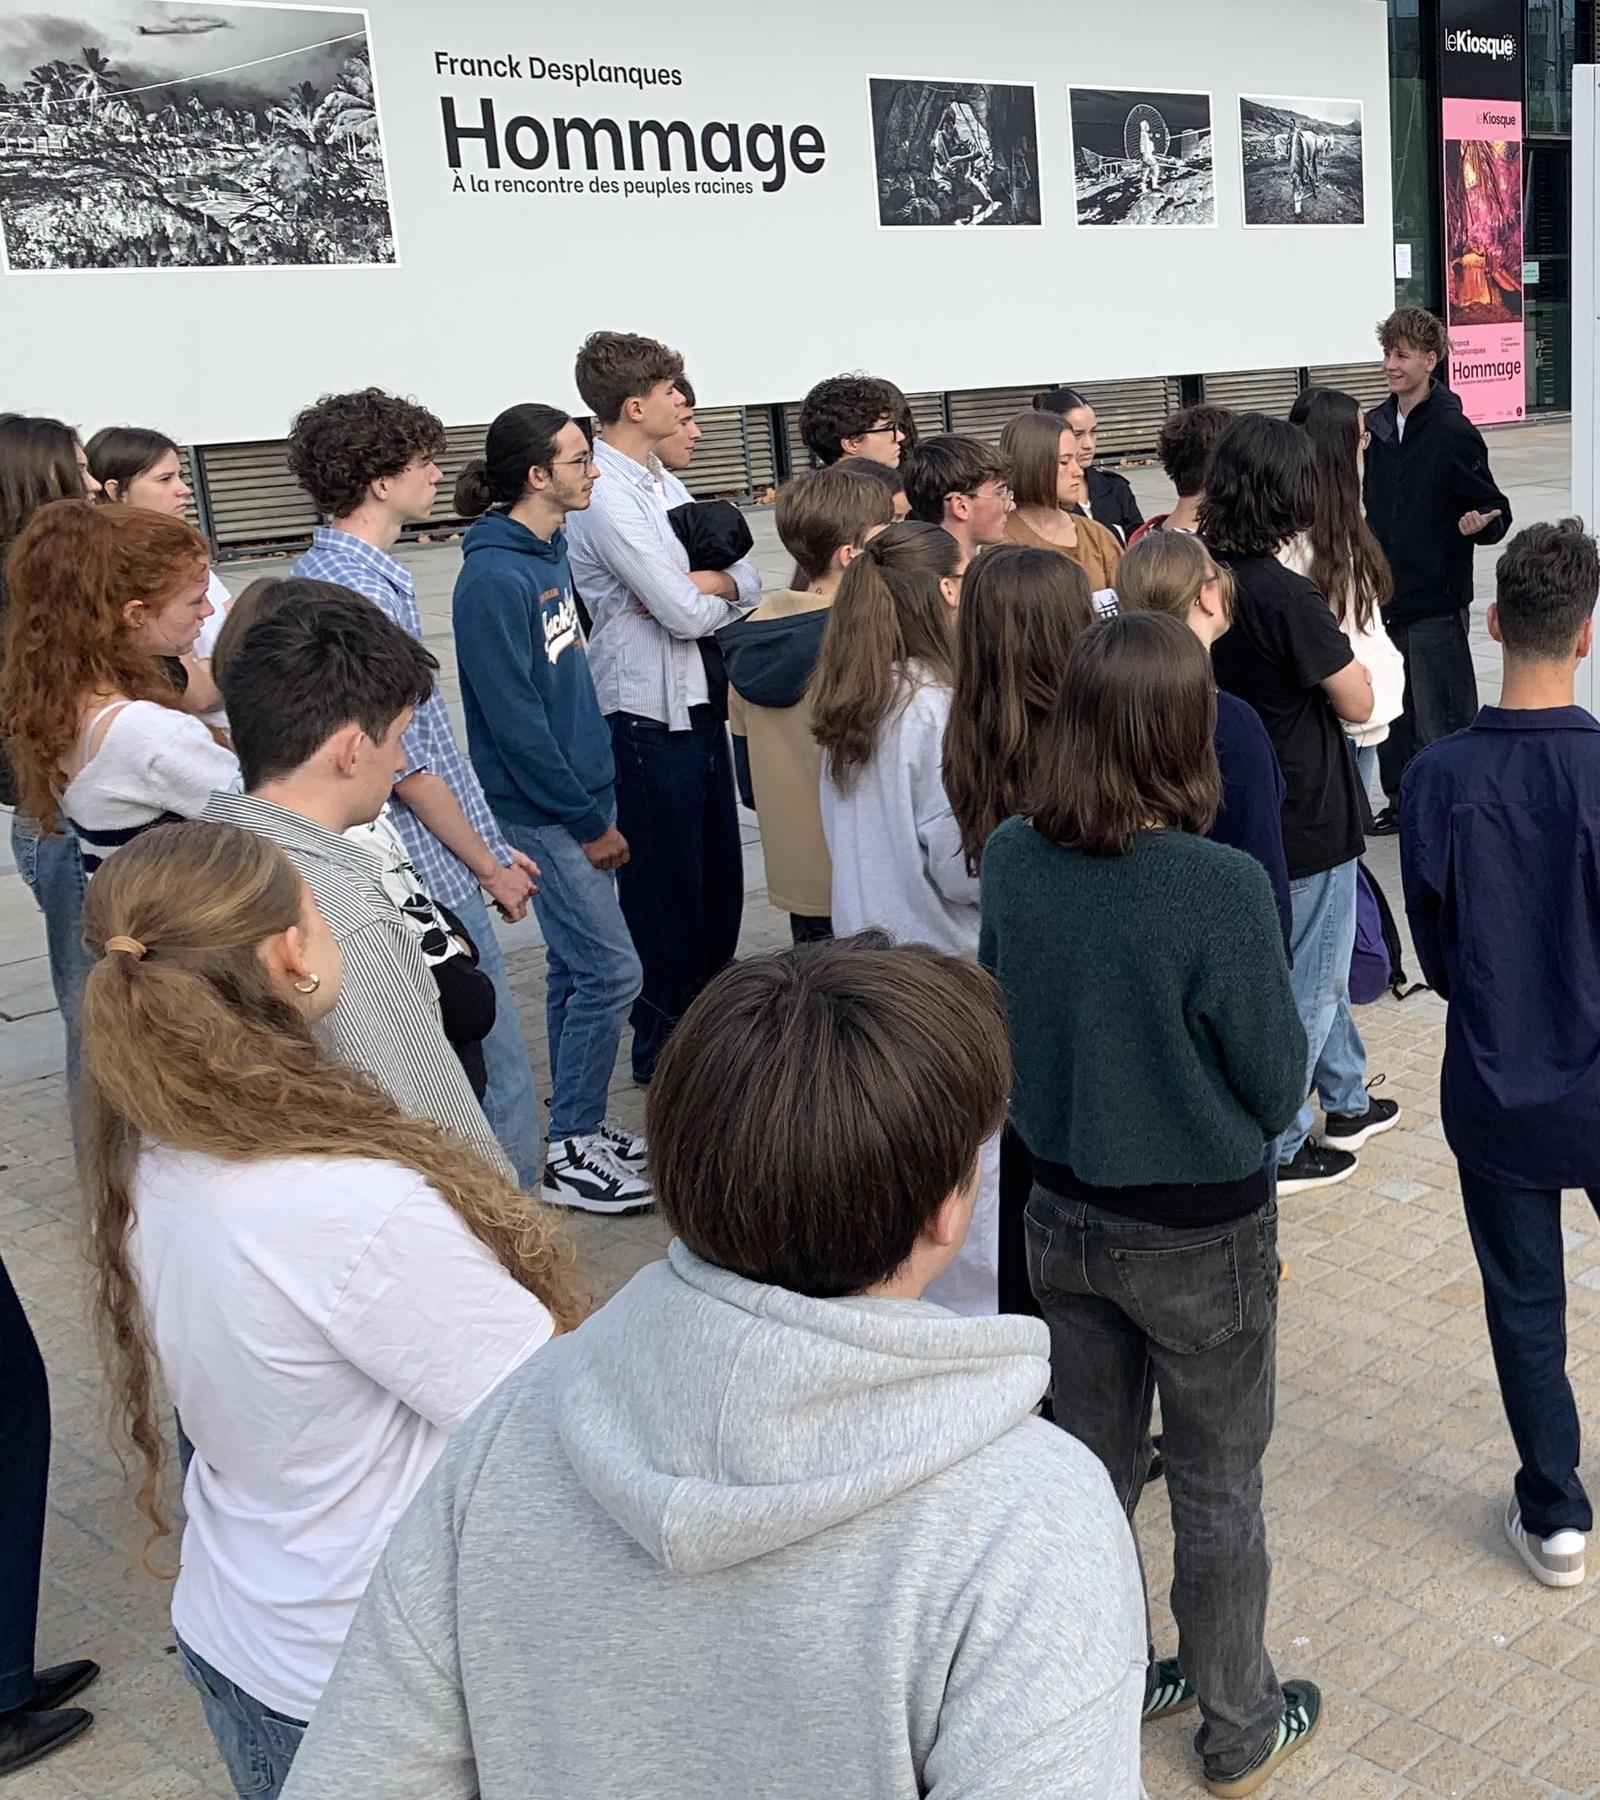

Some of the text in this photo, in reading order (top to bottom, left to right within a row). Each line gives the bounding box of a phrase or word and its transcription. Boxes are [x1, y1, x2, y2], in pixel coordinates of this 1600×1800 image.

[1444, 27, 1514, 61] leKiosque
[434, 51, 682, 90] Franck Desplanques
[440, 96, 826, 193] Hommage
[452, 169, 754, 199] À la rencontre des peuples racines
[1452, 360, 1522, 380] Hommage
